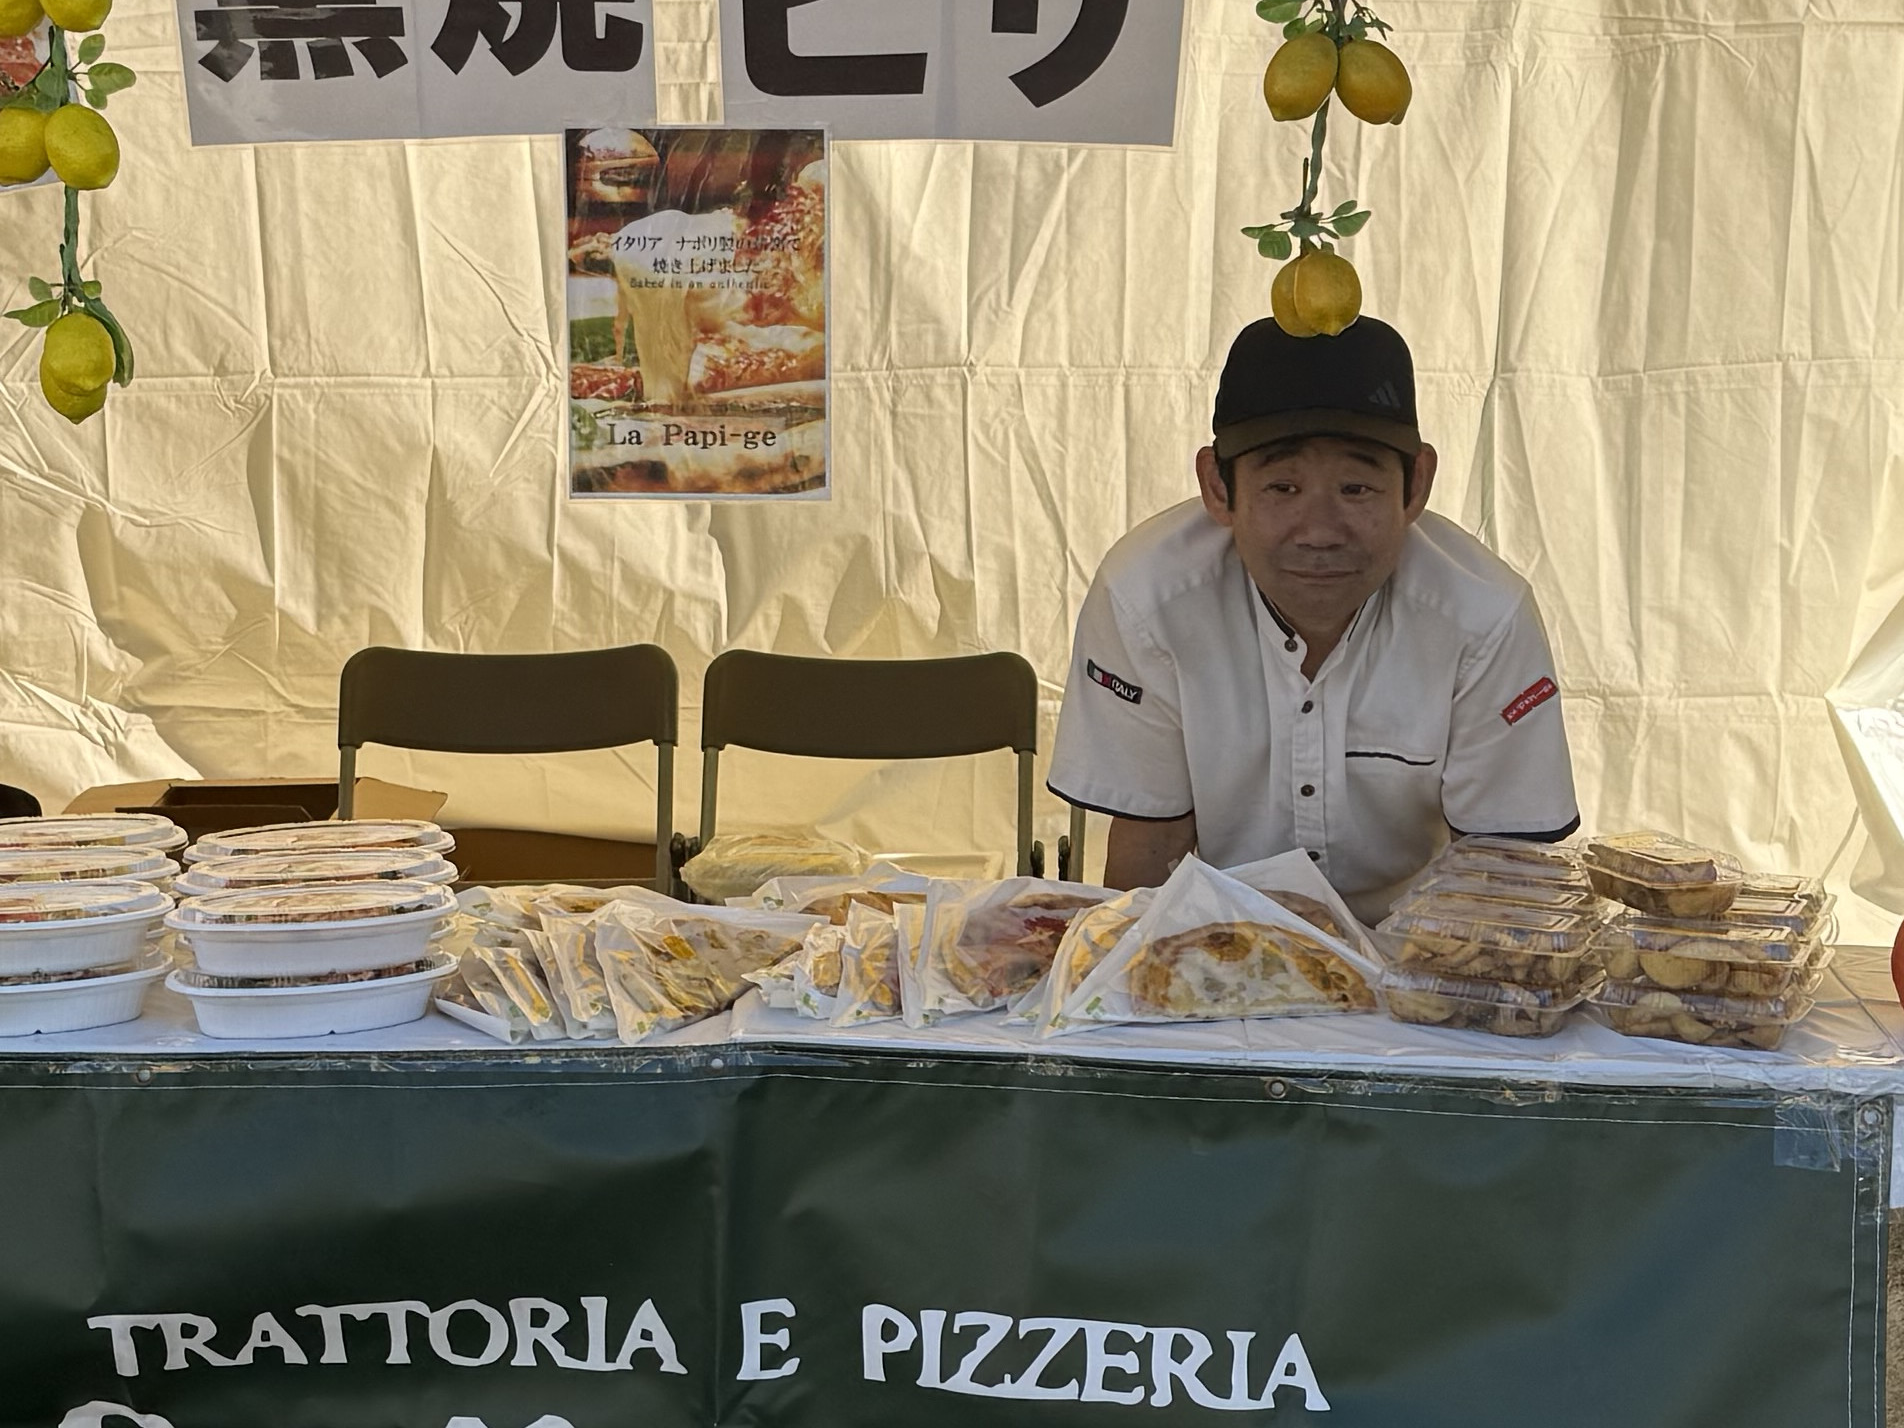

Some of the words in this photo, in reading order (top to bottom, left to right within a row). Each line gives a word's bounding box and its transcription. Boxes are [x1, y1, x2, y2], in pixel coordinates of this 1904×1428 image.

[606, 422, 644, 447] La
[662, 423, 778, 450] Papi-ge
[86, 1294, 688, 1377] TRATTORIA
[737, 1297, 802, 1383] E
[860, 1300, 1332, 1413] PIZZERIA
